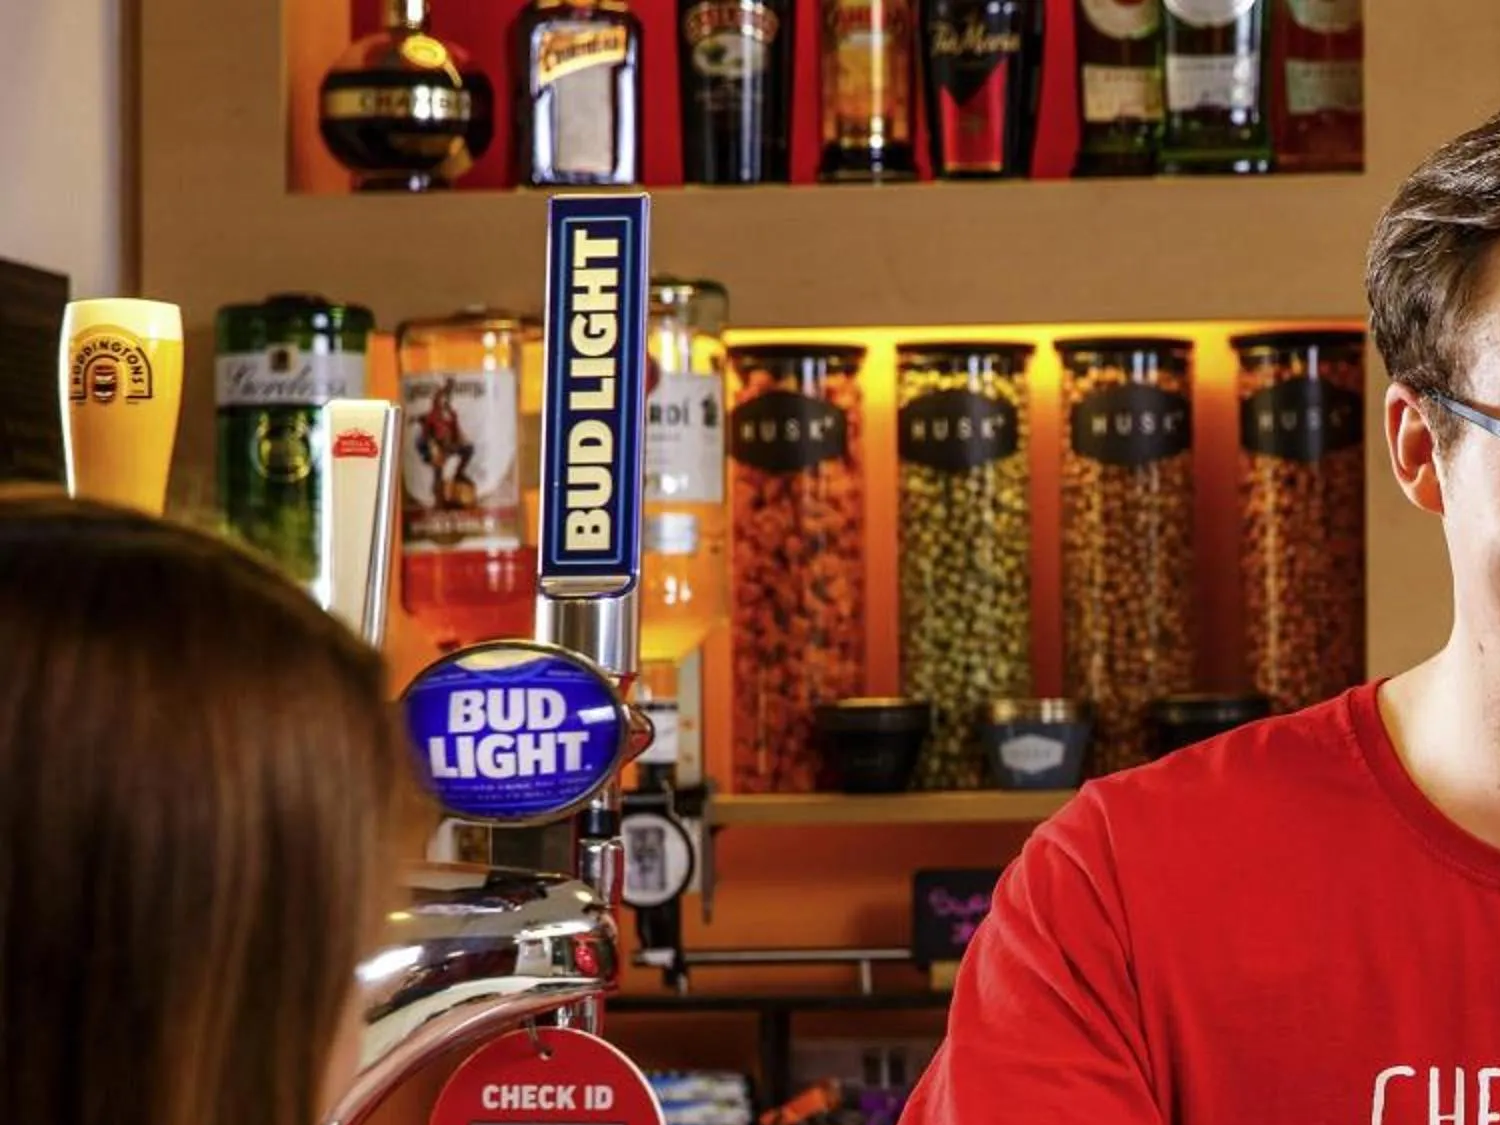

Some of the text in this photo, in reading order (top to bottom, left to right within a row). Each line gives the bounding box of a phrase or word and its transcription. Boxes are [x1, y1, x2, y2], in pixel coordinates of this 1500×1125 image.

[565, 229, 619, 551] BUD LIGHT
[741, 417, 824, 443] HUSK
[911, 416, 995, 442] HUSK
[448, 687, 568, 734] BUD
[428, 731, 590, 779] LIGHT
[482, 1084, 614, 1111] CHECK ID
